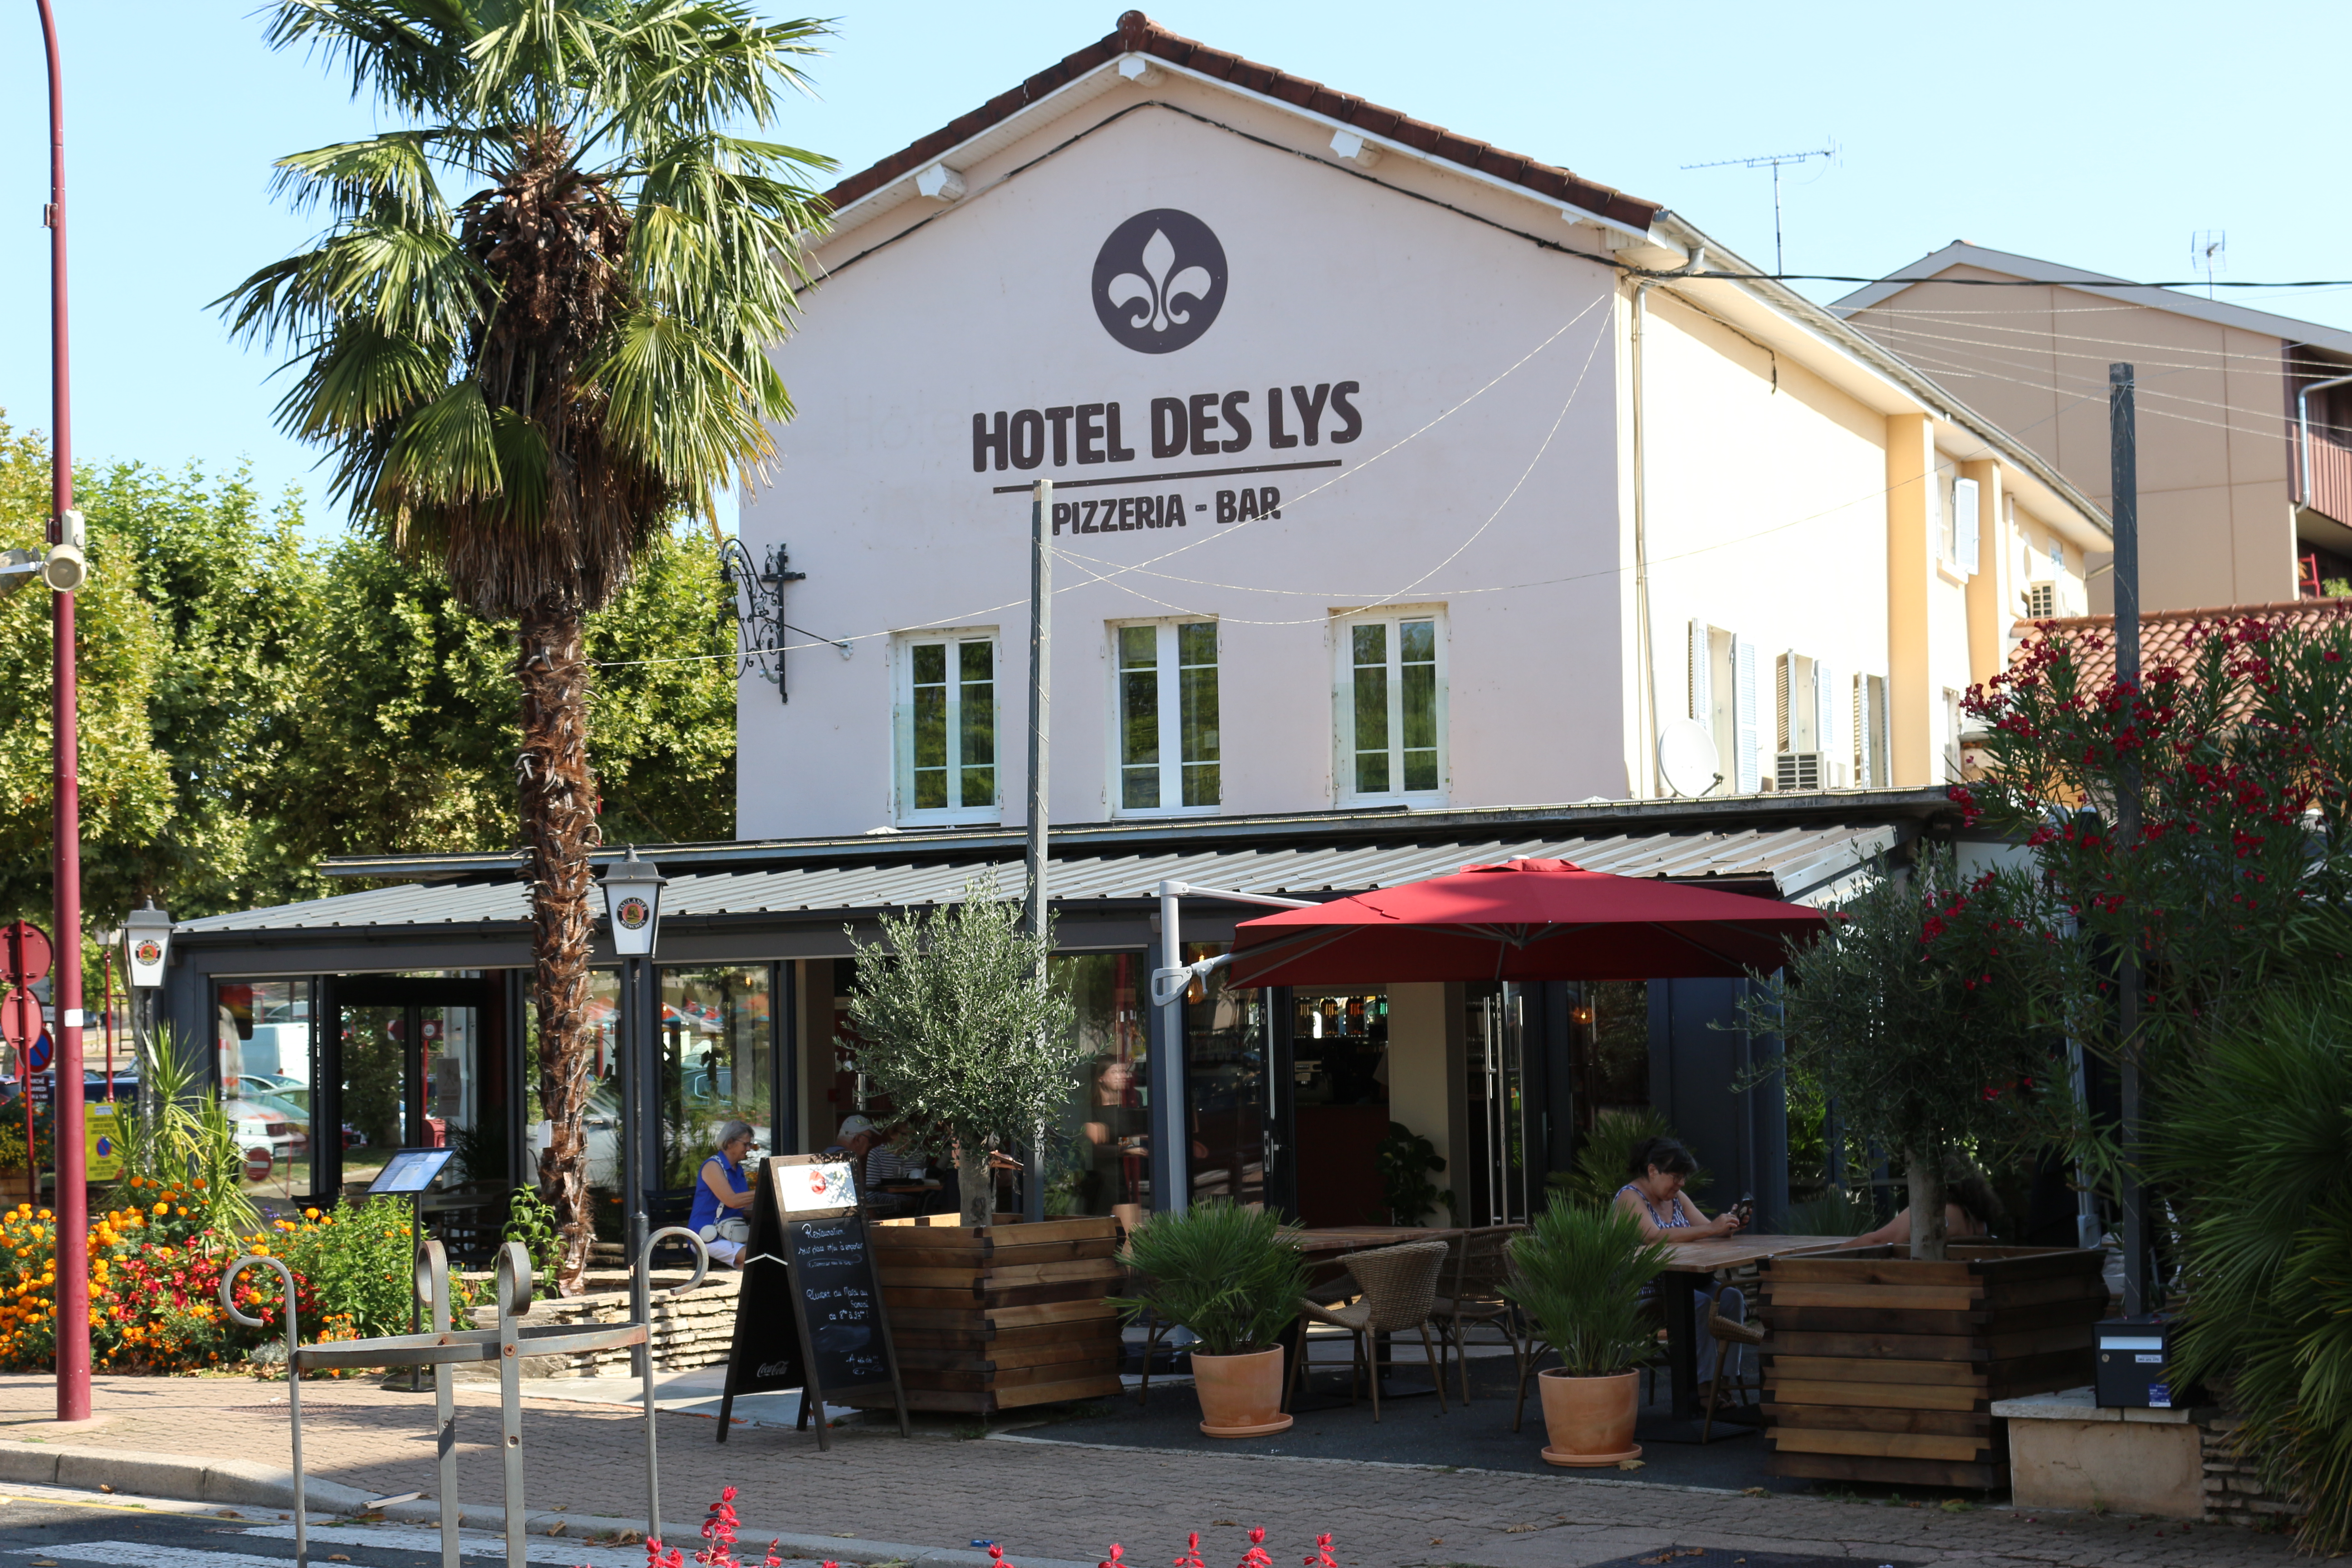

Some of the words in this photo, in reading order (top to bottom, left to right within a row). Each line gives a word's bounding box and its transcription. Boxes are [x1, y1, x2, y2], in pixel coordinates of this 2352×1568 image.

[973, 402, 1135, 472] HOTEL
[1151, 390, 1252, 459] DES
[1268, 381, 1362, 449] LYS
[1052, 494, 1186, 535] PIZZERIA
[1216, 486, 1281, 523] BAR
[618, 898, 647, 911] PAULANER
[620, 920, 646, 929] MÜNCHEN
[802, 1223, 845, 1239] Restauration
[798, 1247, 810, 1255] sur
[812, 1245, 824, 1256] place
[840, 1241, 844, 1250] à
[845, 1243, 863, 1252] emporter
[806, 1288, 831, 1300] Ouvert
[844, 1286, 858, 1299] Mardi
[850, 1300, 869, 1308] Samedi
[849, 1311, 853, 1319] à
